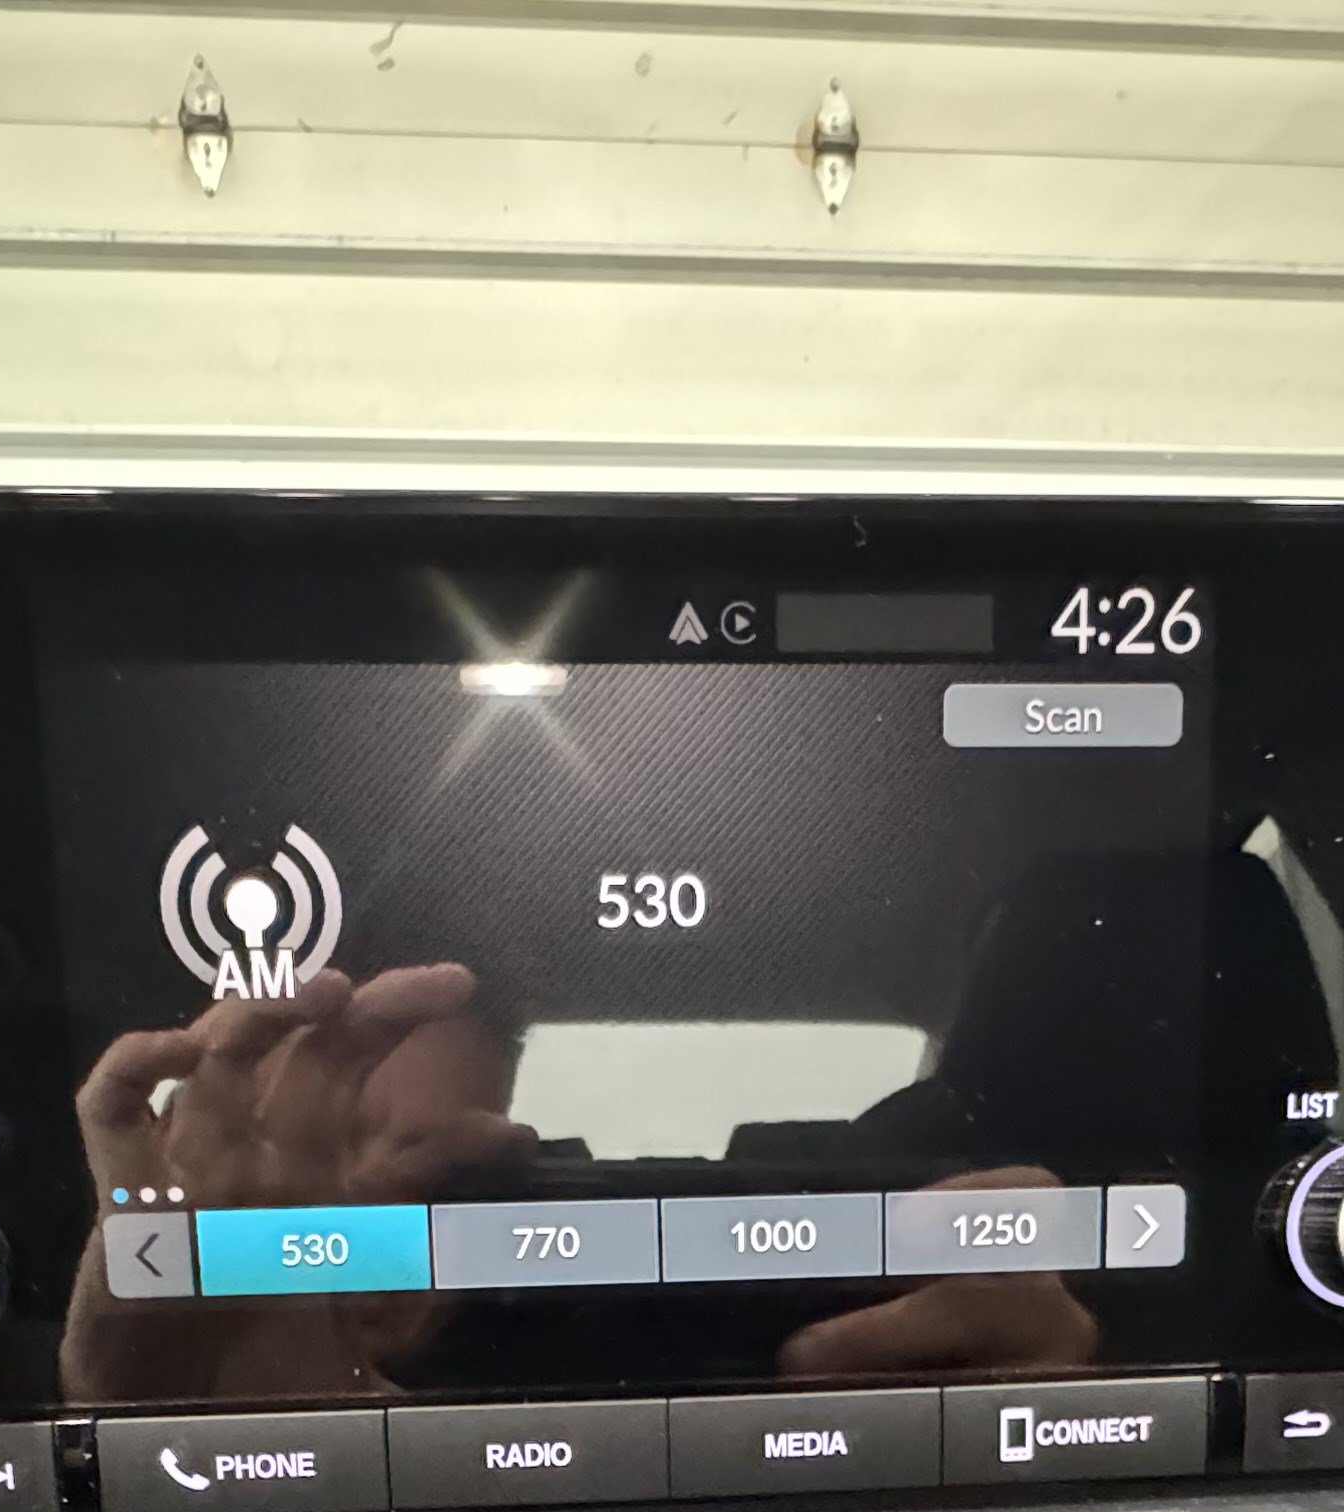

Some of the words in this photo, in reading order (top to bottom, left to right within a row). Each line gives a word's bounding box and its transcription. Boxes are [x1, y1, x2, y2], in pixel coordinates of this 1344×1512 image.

[1050, 586, 1203, 656] 4:26
[1024, 699, 1103, 735] Scan
[597, 872, 707, 930] 530
[213, 949, 296, 1000] AM
[1286, 1091, 1340, 1120] LIST
[511, 1226, 581, 1260] 770
[729, 1219, 818, 1253] 1000
[952, 1212, 1038, 1247] 1250
[280, 1233, 350, 1268] 530
[763, 1430, 849, 1459] MEDIA
[1035, 1415, 1154, 1446] CONNECT
[215, 1451, 317, 1481] PHONE
[485, 1440, 573, 1470] RADIO
